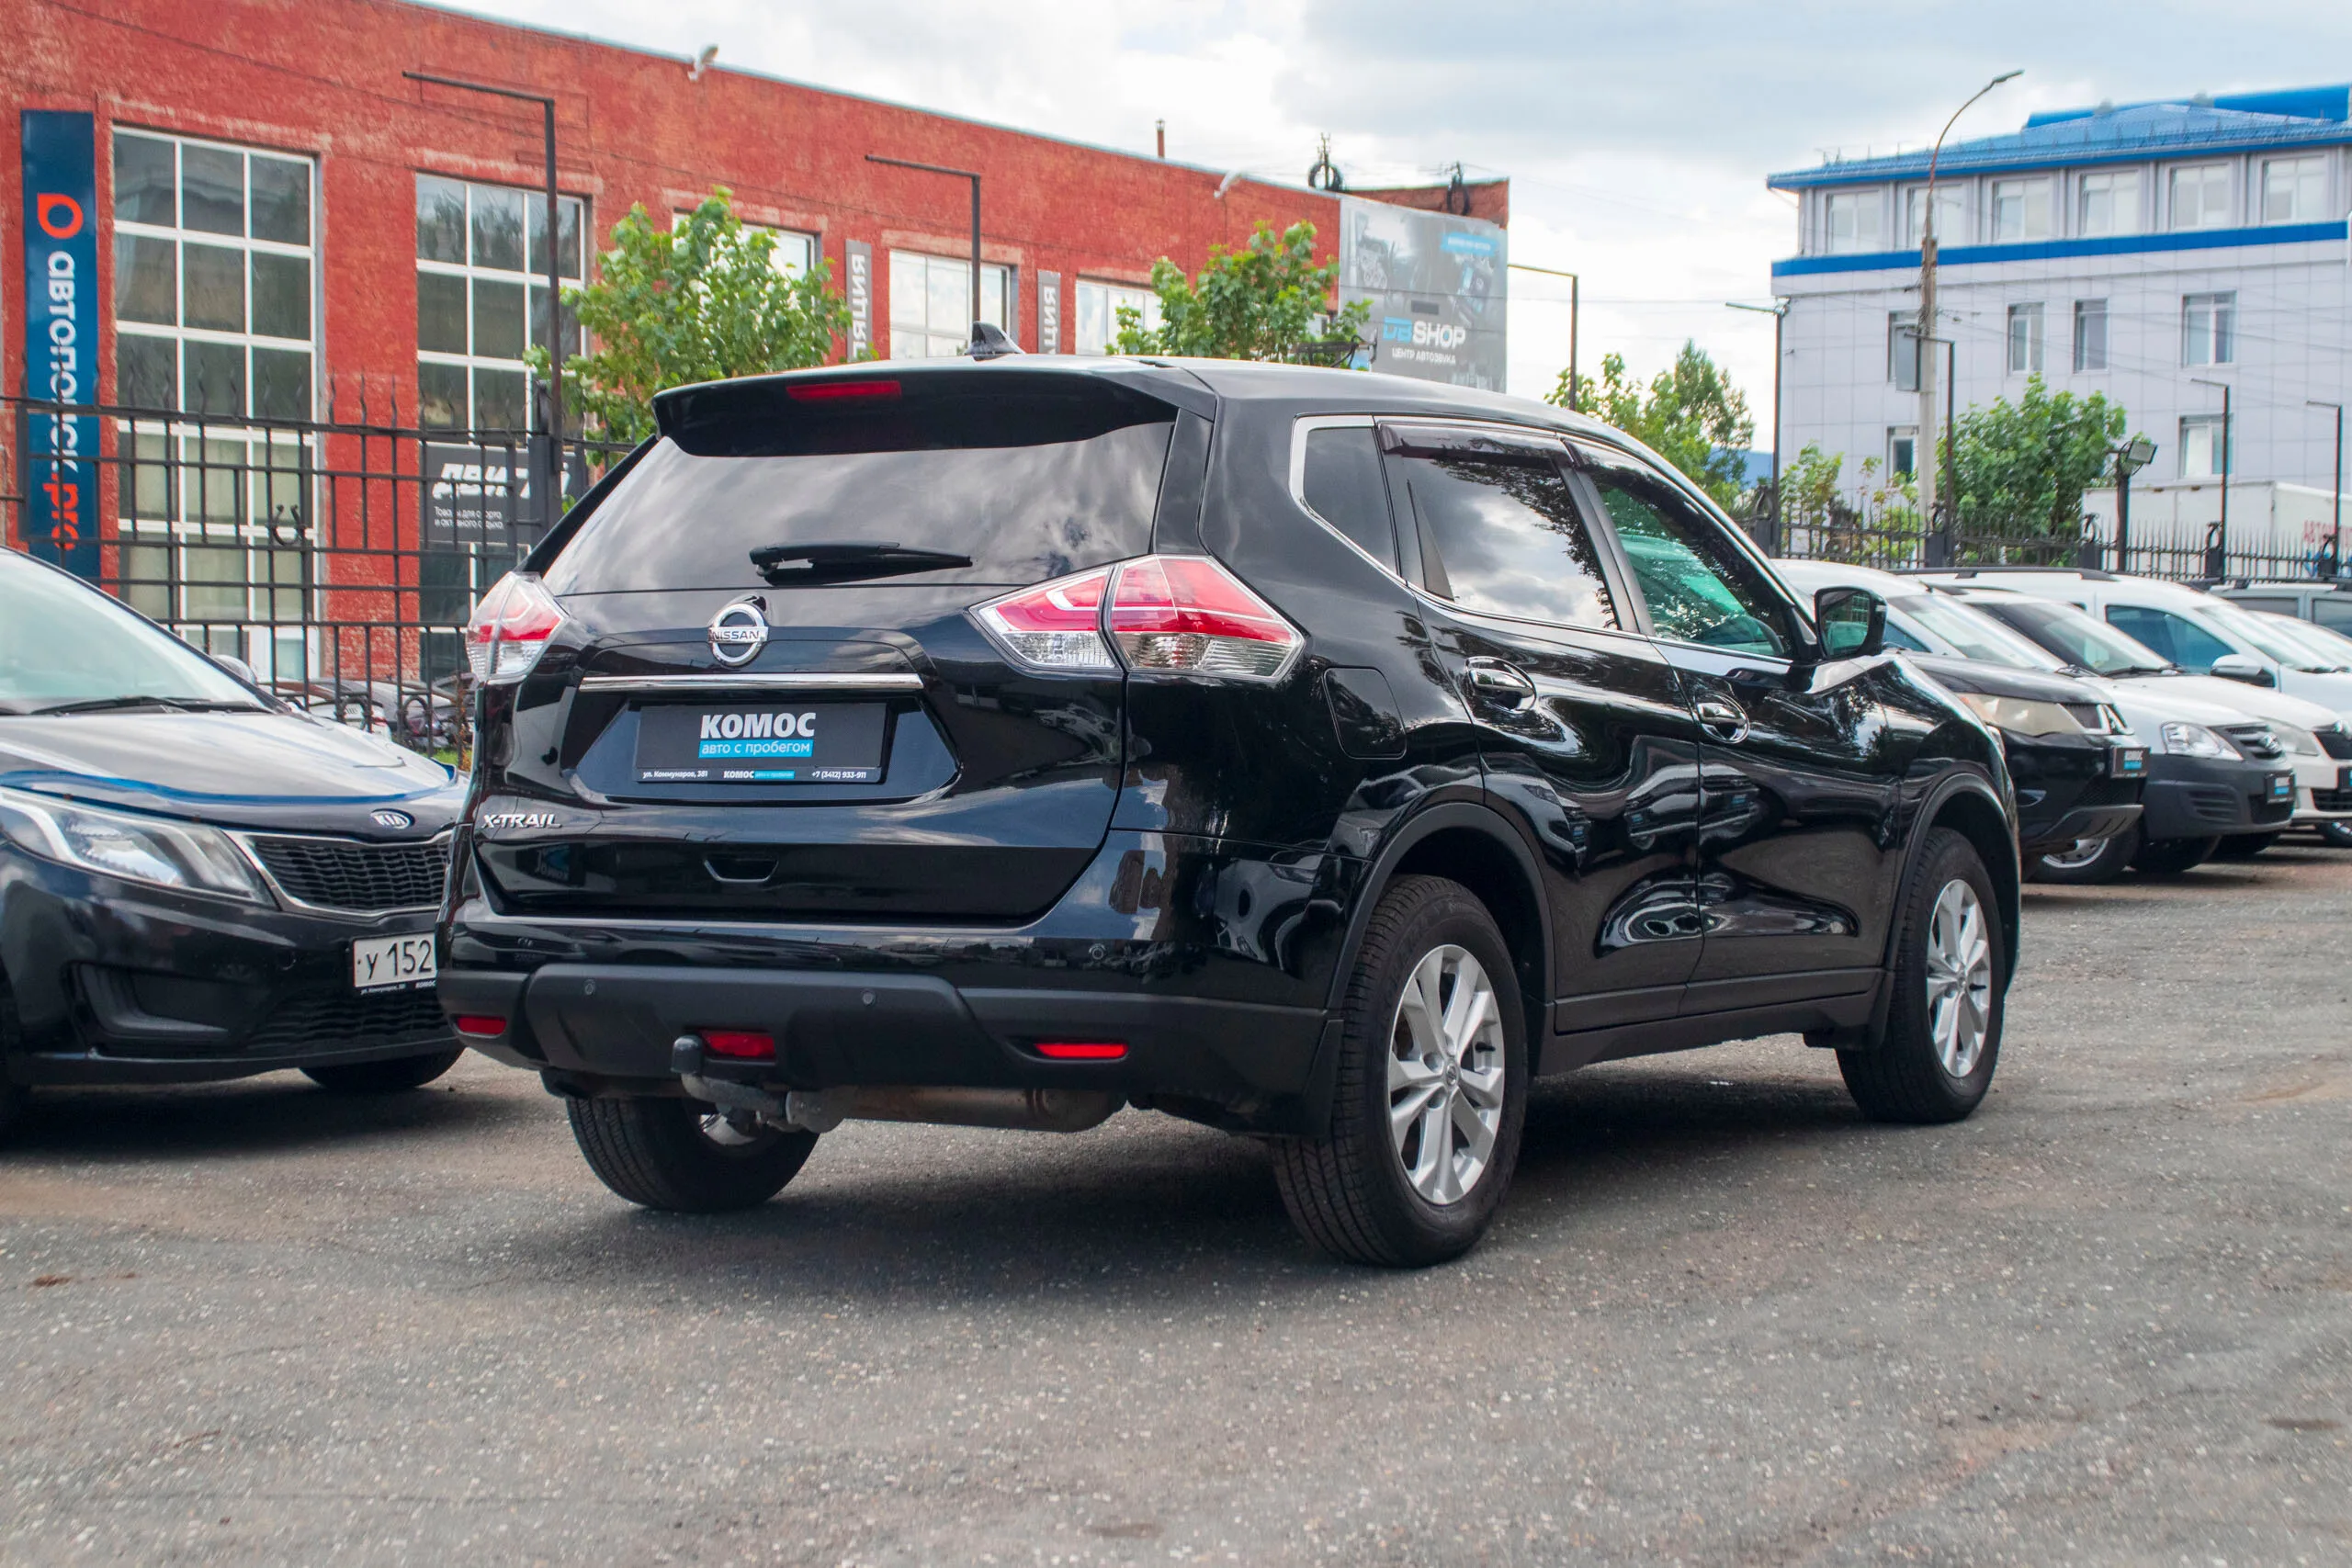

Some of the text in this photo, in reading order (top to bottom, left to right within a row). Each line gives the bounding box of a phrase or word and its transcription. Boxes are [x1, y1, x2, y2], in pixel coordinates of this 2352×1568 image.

[1392, 347, 1415, 359] ЦЕНТР
[712, 631, 760, 640] NISSAN
[700, 713, 816, 739] КОМОС
[702, 741, 810, 755] авто с пробегом
[723, 771, 754, 779] КОМОС
[821, 771, 841, 780] (3412)
[842, 771, 866, 779] 933-911
[375, 814, 405, 827] KIA
[481, 814, 561, 829] X-TRAIL
[387, 939, 432, 976] 152
